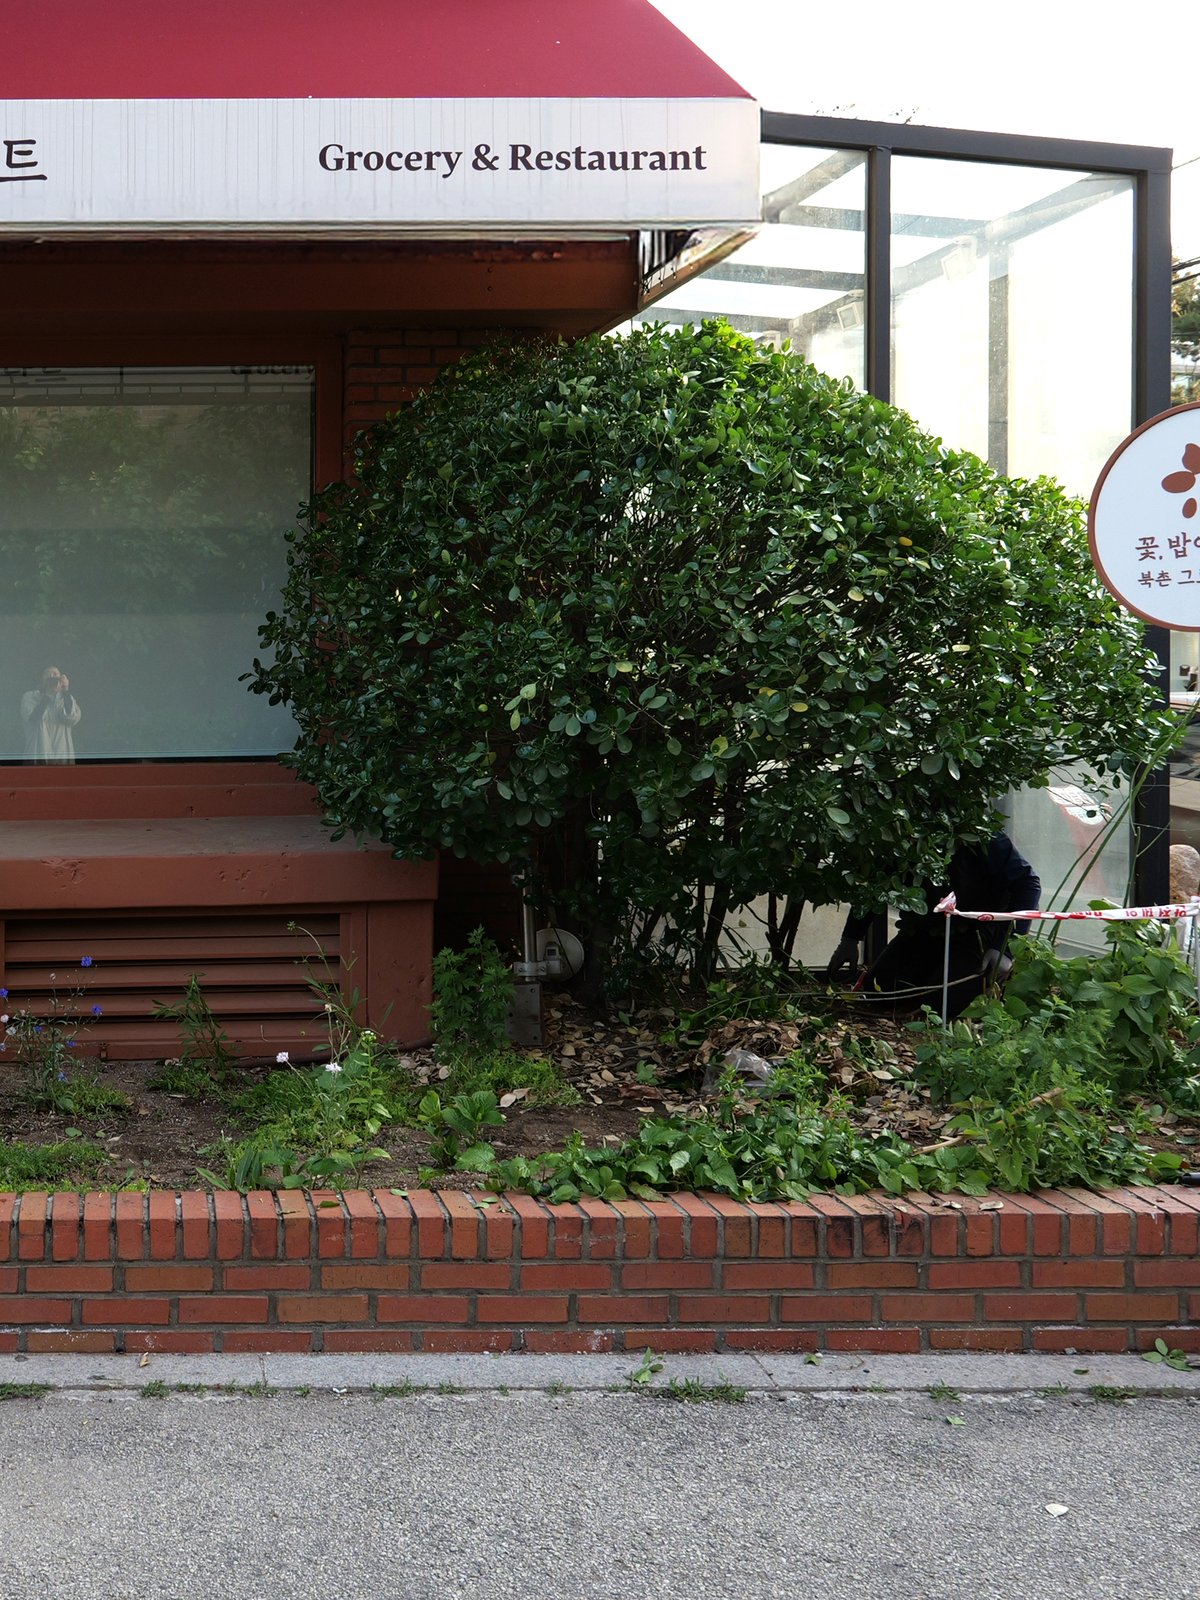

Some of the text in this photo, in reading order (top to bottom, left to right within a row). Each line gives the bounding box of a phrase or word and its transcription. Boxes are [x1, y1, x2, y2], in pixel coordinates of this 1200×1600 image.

[318, 143, 708, 179] Grocery & Restaurant
[1137, 570, 1200, 588] 북촌 그
